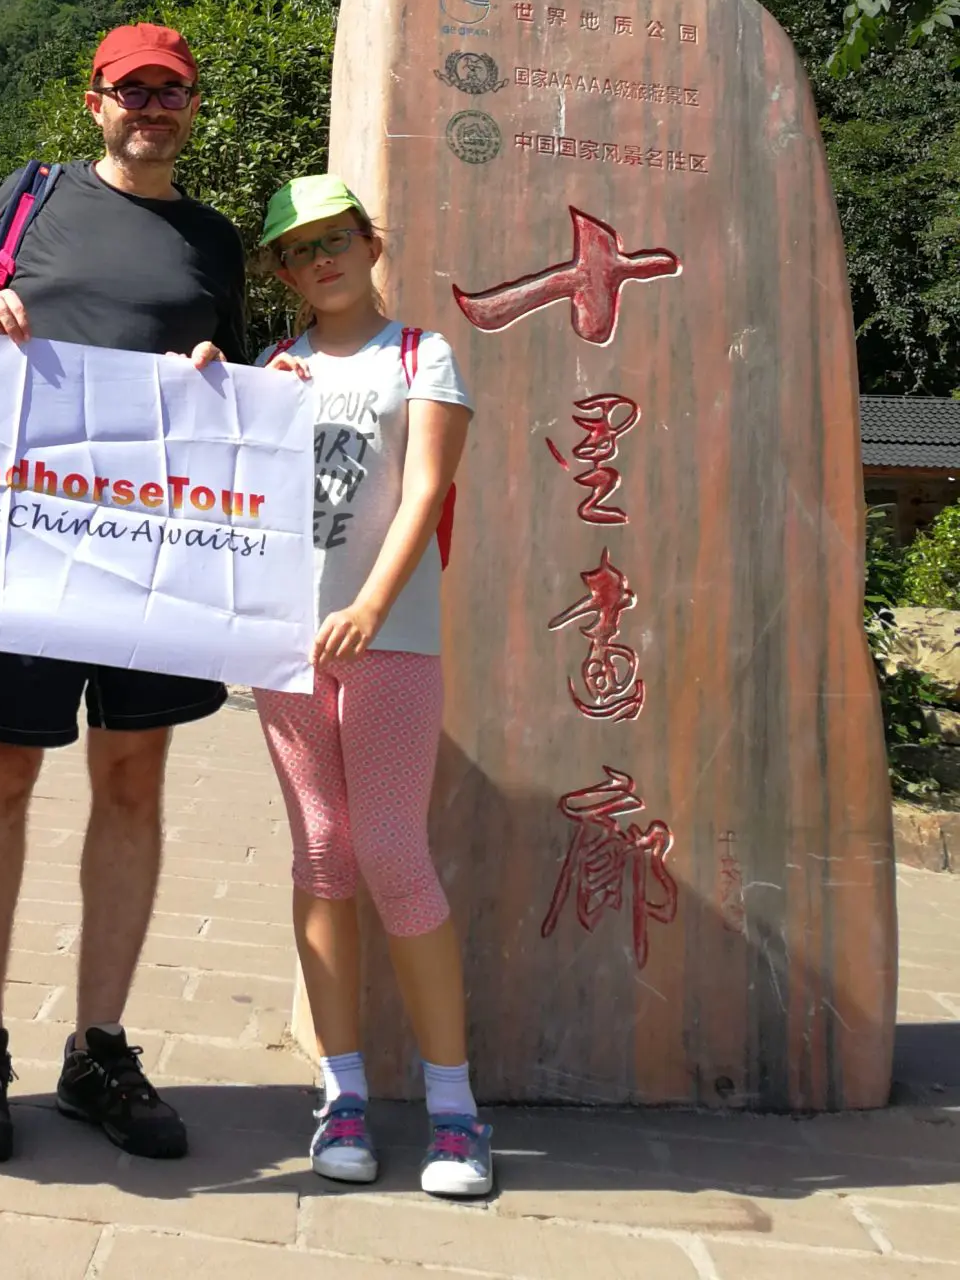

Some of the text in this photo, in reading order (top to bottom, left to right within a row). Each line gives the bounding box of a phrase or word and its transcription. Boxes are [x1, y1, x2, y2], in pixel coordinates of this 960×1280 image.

[513, 2, 699, 45] 世界地质公园
[514, 66, 700, 107] 国家AAAAA级旅游景区
[514, 132, 709, 173] 中国国家风景名胜区
[316, 389, 380, 425] YOUR
[9, 503, 128, 539] China
[131, 519, 267, 557] Awaits!
